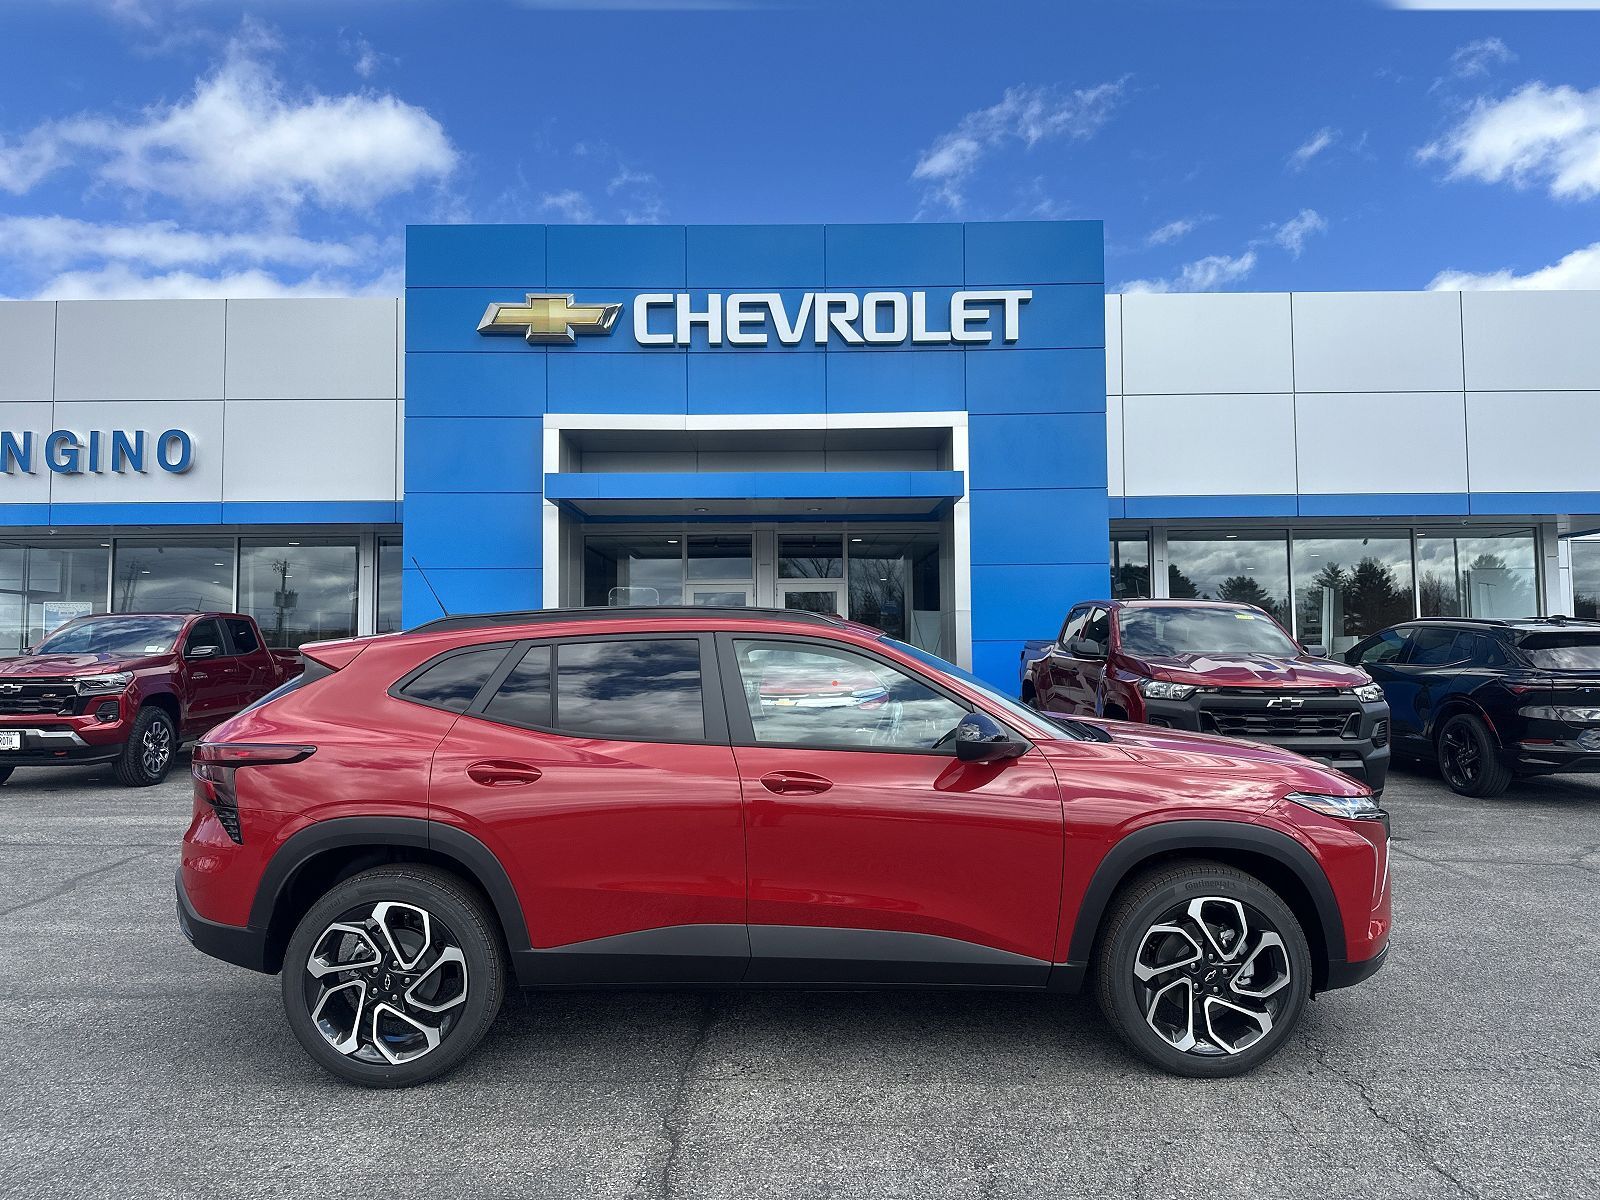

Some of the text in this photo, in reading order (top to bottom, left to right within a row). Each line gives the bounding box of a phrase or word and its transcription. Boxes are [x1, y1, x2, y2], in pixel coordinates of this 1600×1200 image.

[633, 289, 1033, 346] CHEVROLET
[0, 429, 194, 474] NGINO
[1185, 879, 1230, 891] Continental
